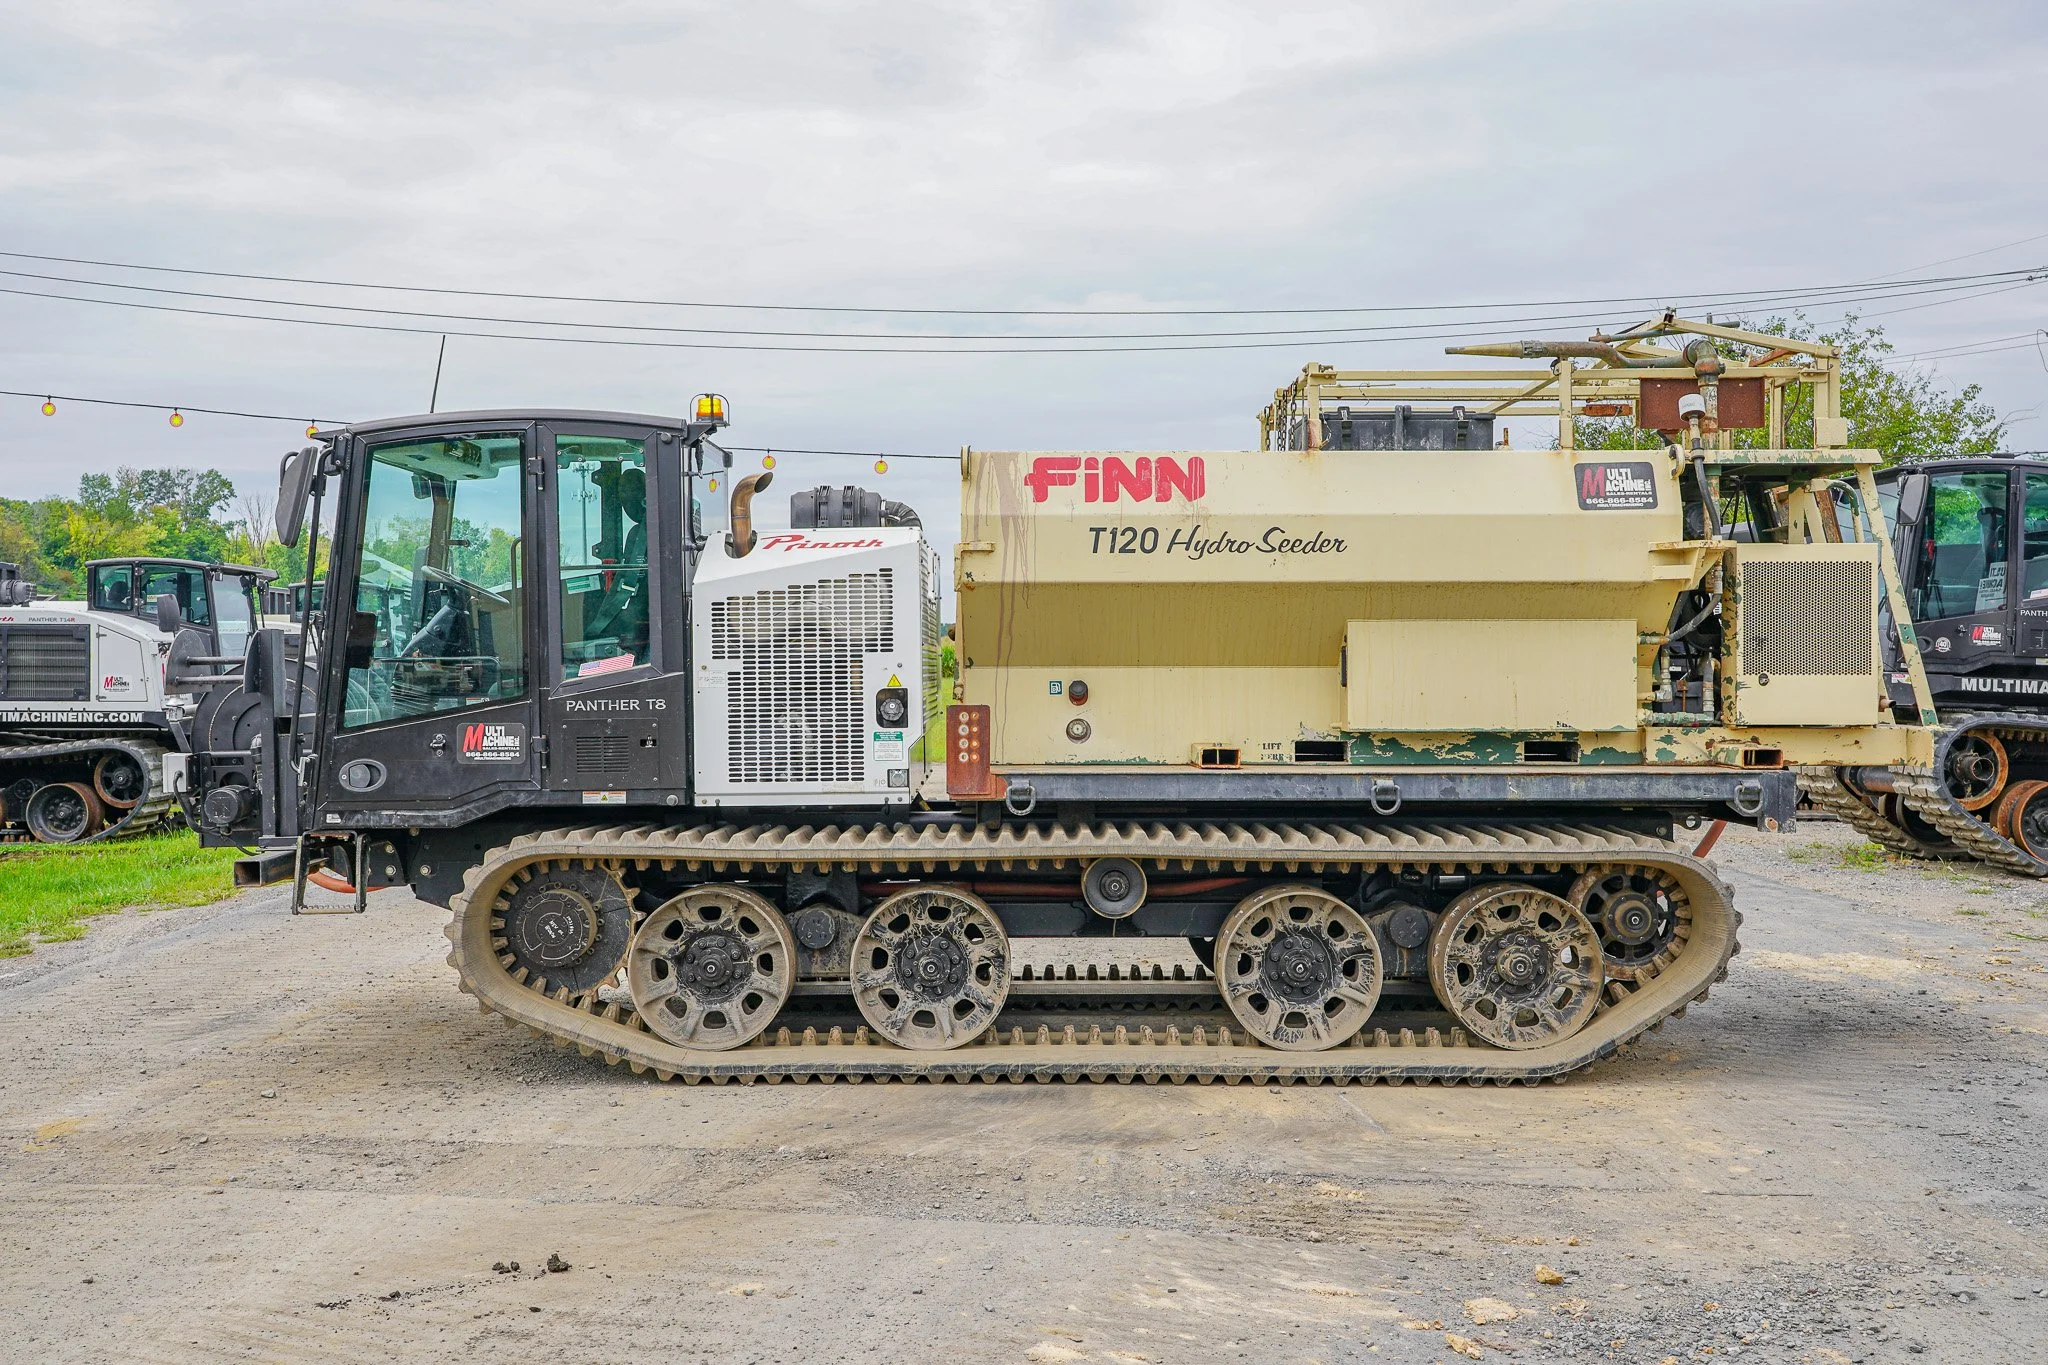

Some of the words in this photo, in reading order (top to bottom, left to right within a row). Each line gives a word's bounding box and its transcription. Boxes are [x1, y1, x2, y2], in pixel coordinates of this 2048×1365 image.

[761, 534, 884, 552] Prinoth
[1089, 527, 1159, 554] T120
[1961, 678, 2048, 694] MULTIMA
[566, 699, 641, 712] PANTHER
[645, 698, 667, 711] T8
[0, 712, 143, 723] IMACHINEINC.COM
